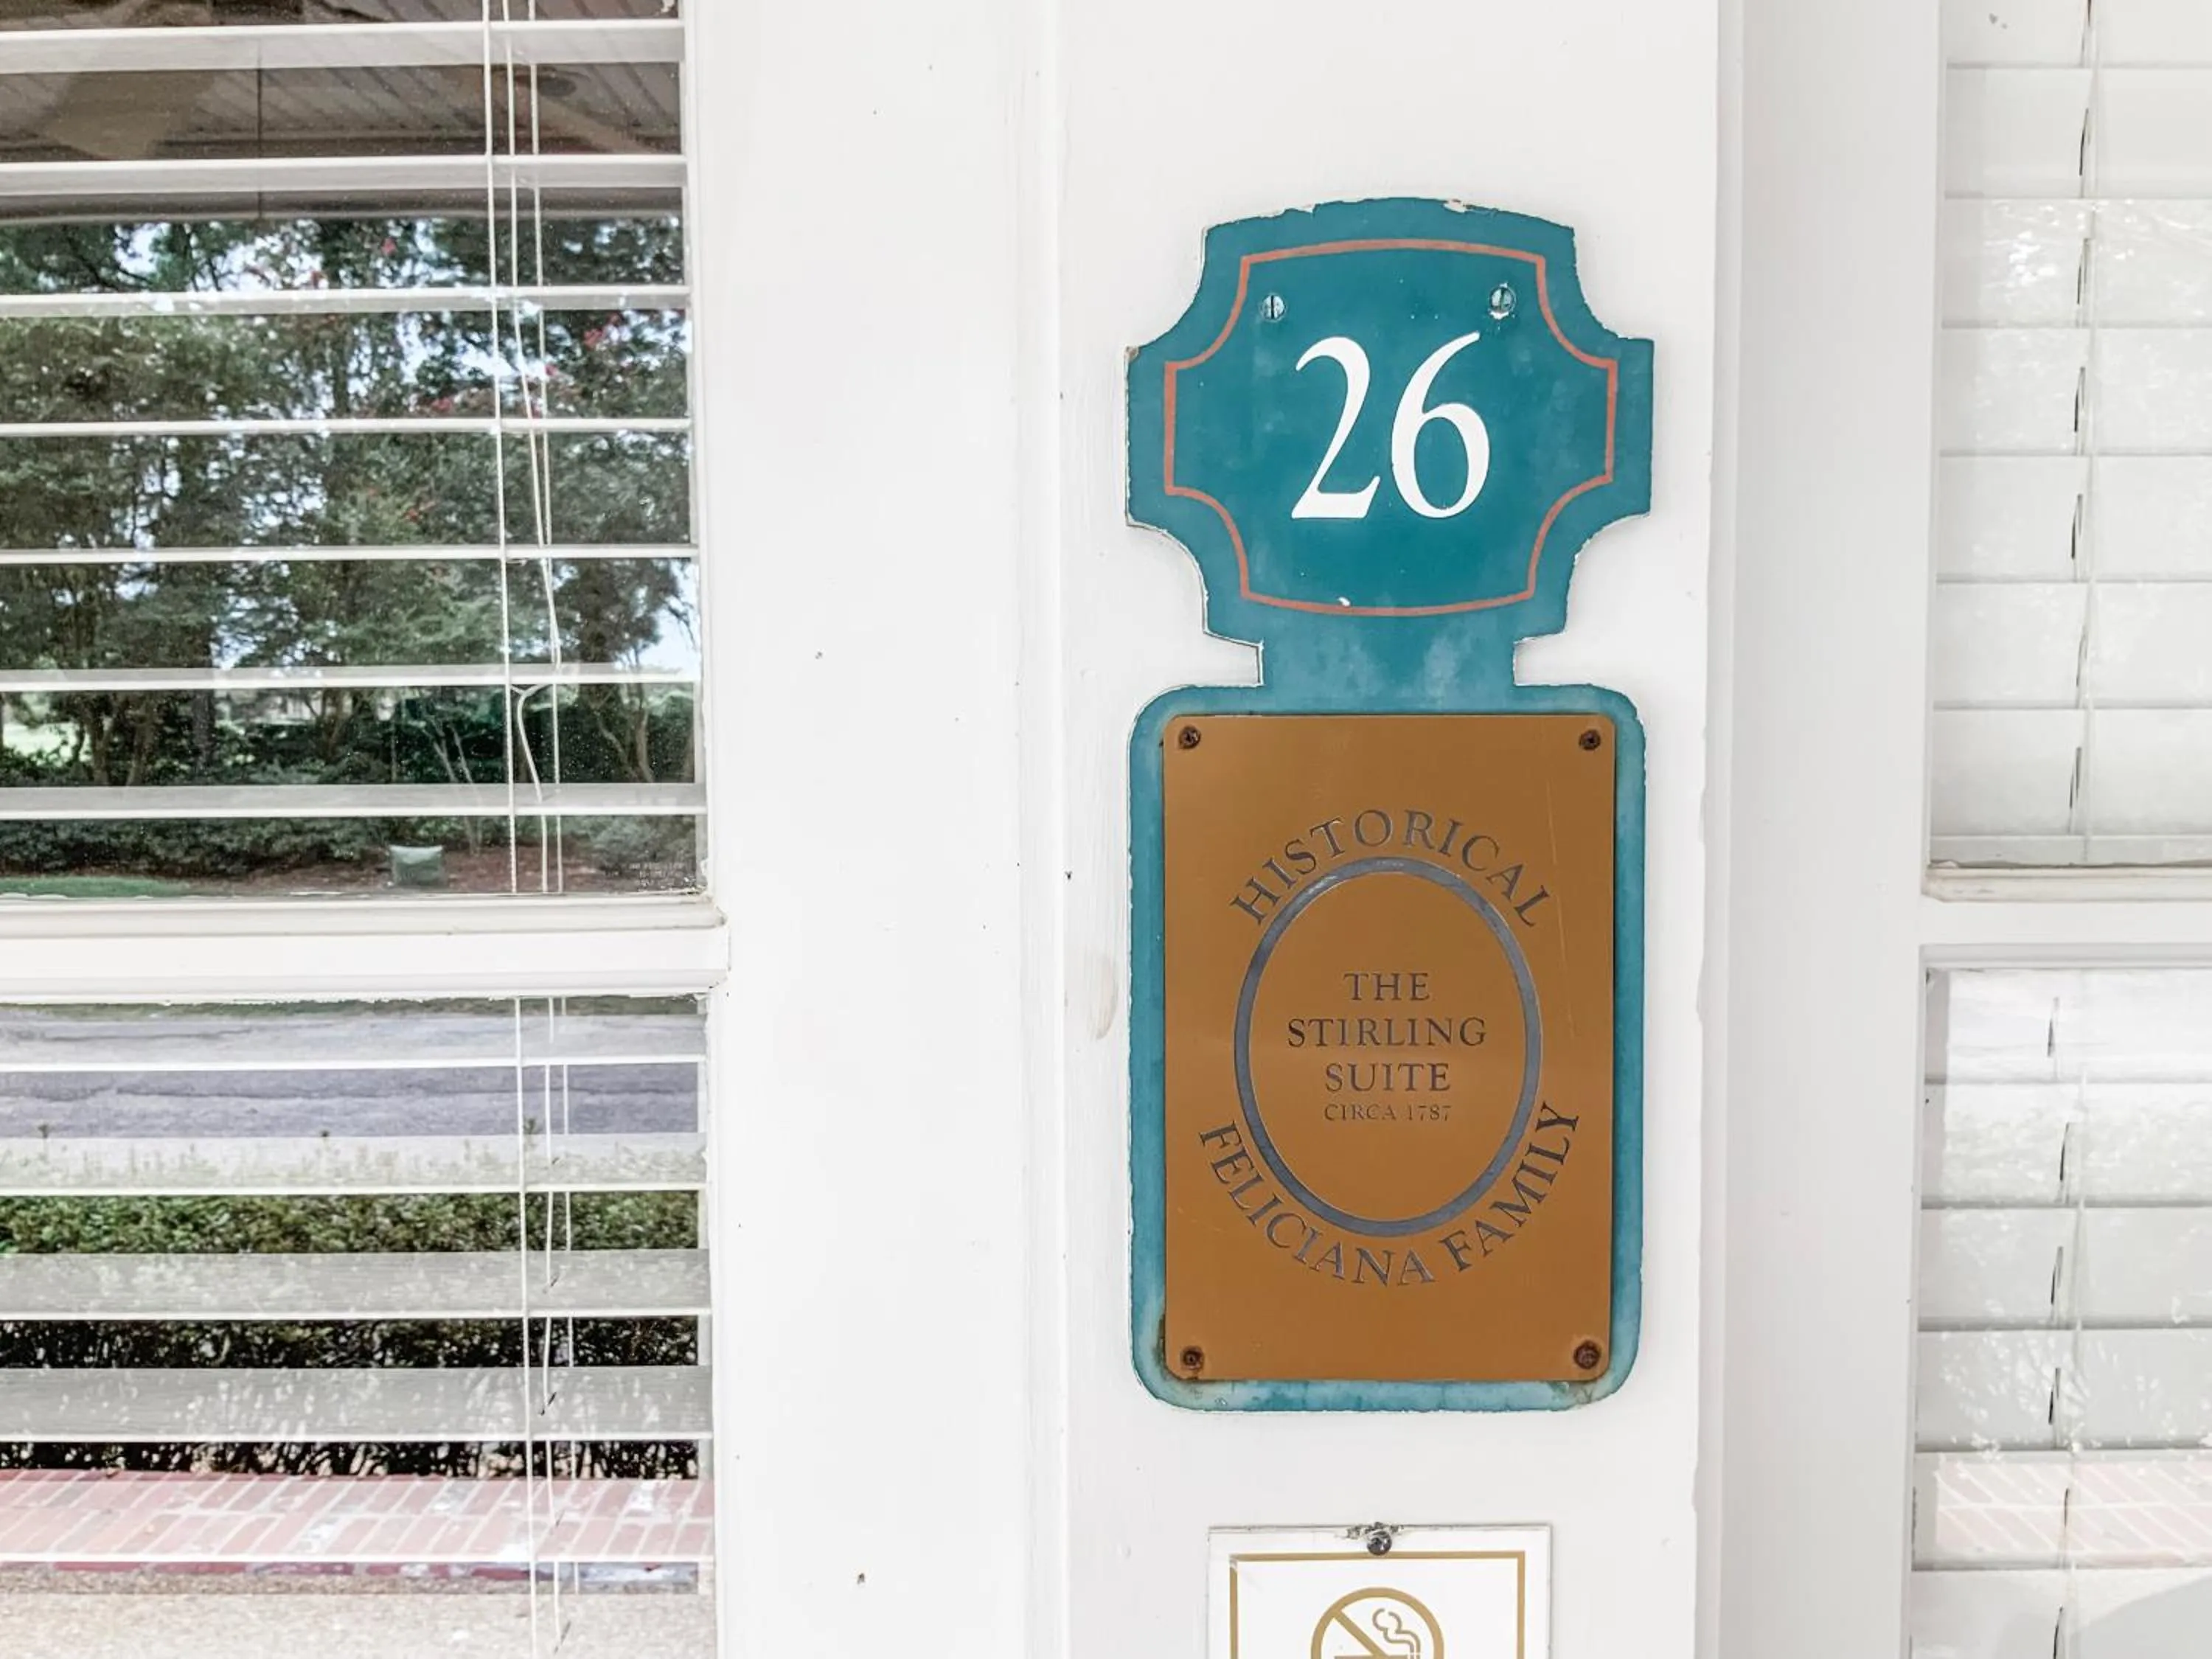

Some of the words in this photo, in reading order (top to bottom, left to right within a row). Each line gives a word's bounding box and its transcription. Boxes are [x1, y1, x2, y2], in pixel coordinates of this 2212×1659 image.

[1291, 331, 1490, 519] 26
[1231, 809, 1551, 926] HISTORICAL
[1344, 973, 1429, 1001] THE
[1287, 1018, 1487, 1048] STIRLING
[1325, 1062, 1450, 1093] SUITE
[1324, 1104, 1397, 1121] CIRCA
[1407, 1104, 1451, 1121] 1787
[1200, 1121, 1435, 1286] FELICIANA
[1439, 1102, 1579, 1273] FAMILY
